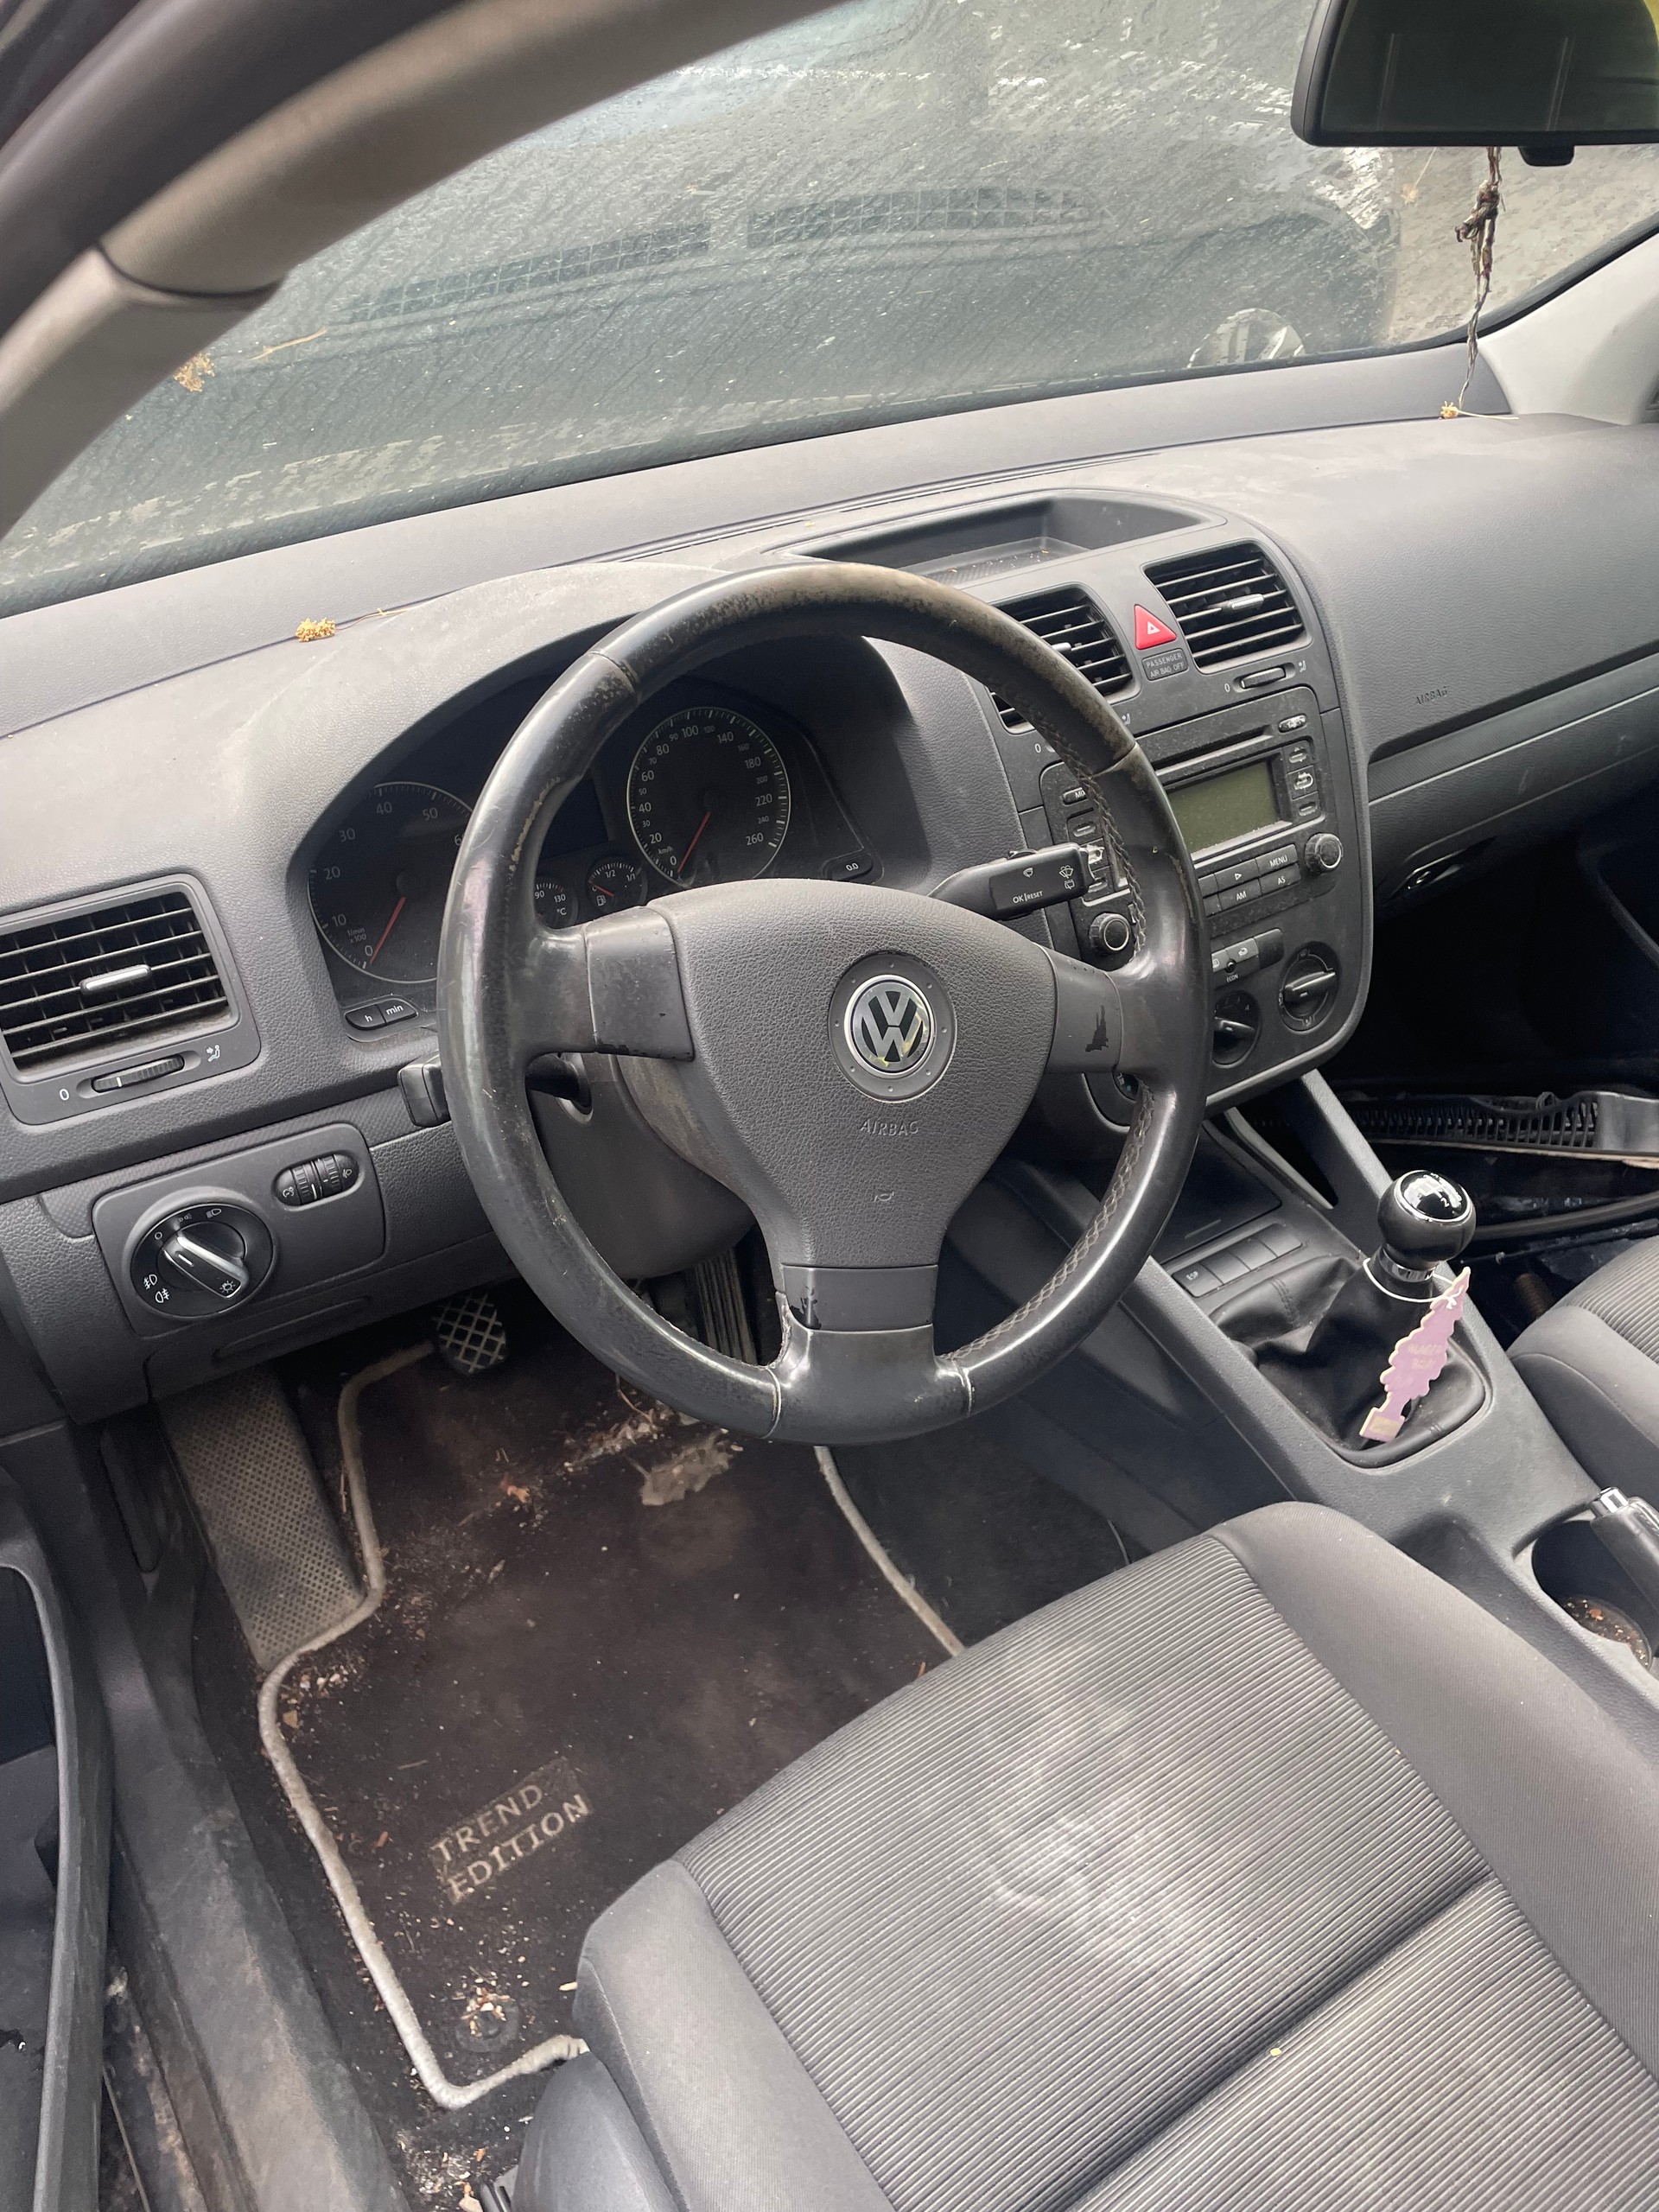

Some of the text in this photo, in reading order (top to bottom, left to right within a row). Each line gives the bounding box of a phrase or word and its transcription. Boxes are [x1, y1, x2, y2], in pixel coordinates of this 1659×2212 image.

[1146, 652, 1183, 668] PASSENGER
[1173, 661, 1185, 671] OFF
[669, 733, 679, 741] 90
[682, 724, 699, 738] 100
[716, 731, 734, 744] 140
[656, 743, 670, 756] 80
[648, 757, 658, 766] 70
[744, 756, 761, 769] 180
[641, 770, 655, 782] 60
[756, 775, 768, 785] 200
[639, 787, 647, 796] 50
[755, 793, 772, 807] 220
[376, 801, 392, 815] 40
[639, 802, 652, 813] 40
[422, 807, 438, 821] 50
[758, 815, 770, 824] 240
[339, 828, 356, 842] 30
[454, 833, 464, 847] 6
[649, 832, 663, 844] 20
[745, 832, 764, 846] 260
[658, 846, 673, 855] km/h
[670, 855, 677, 866] 0
[1269, 855, 1288, 868] MENU
[323, 866, 341, 880] 20
[605, 869, 617, 879] 1/2
[626, 873, 636, 882] 1/1
[1277, 875, 1286, 885] AS
[534, 890, 545, 899] 90
[553, 893, 566, 904] 130
[1236, 891, 1247, 901] AM
[331, 913, 347, 927] 10
[346, 927, 365, 938] 1/min
[364, 944, 373, 957] 0
[1226, 974, 1239, 983] ECON
[385, 1005, 404, 1015] min
[860, 1119, 919, 1136] AIRBAG
[1440, 1196, 1450, 1207] 2
[430, 1784, 543, 1862] TREND
[447, 1793, 590, 1905] EDITION
